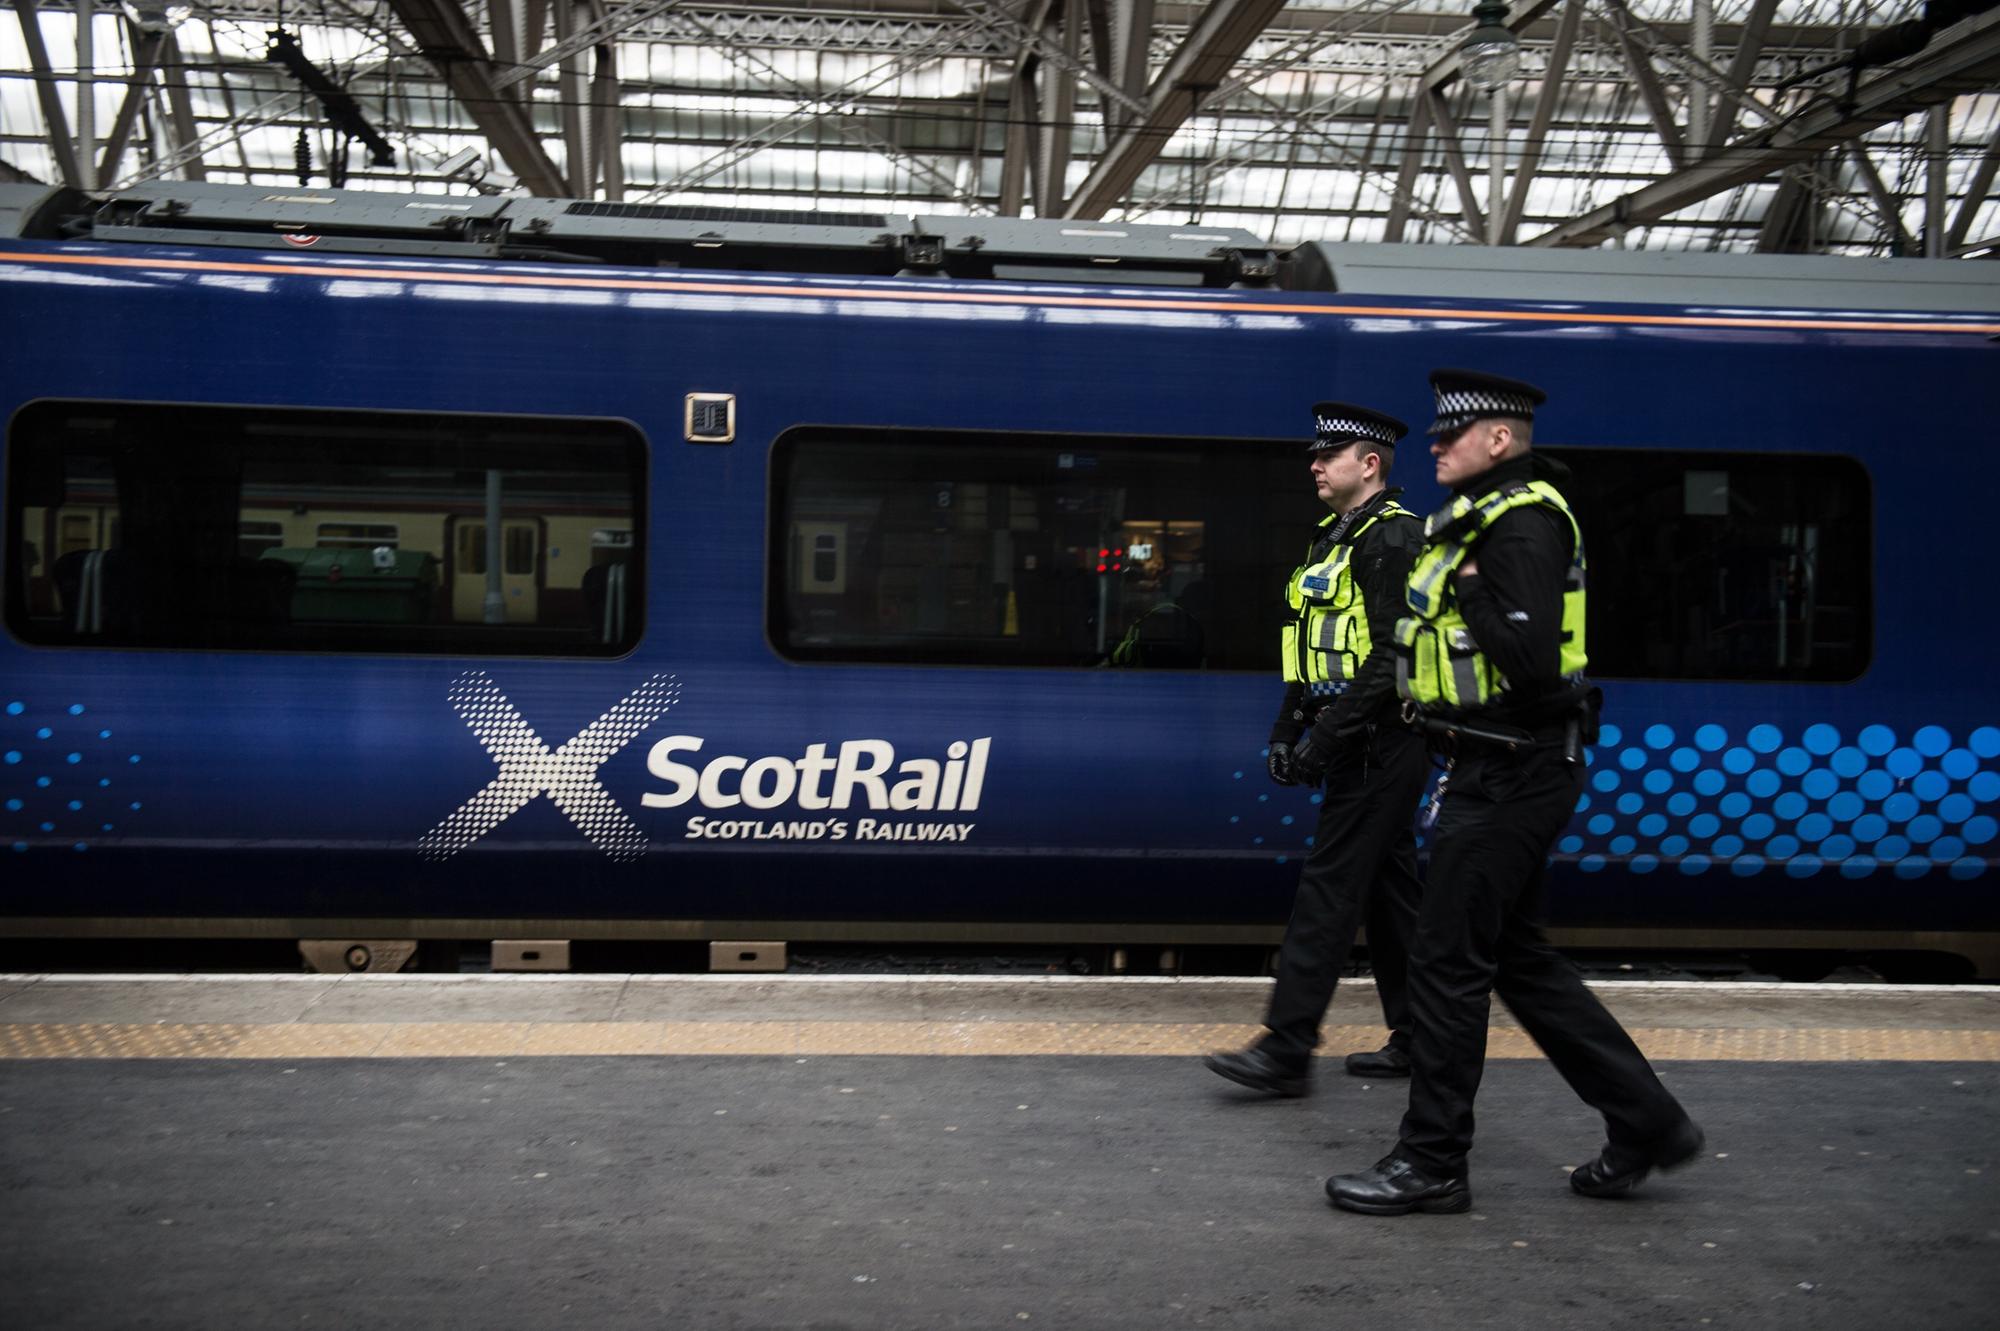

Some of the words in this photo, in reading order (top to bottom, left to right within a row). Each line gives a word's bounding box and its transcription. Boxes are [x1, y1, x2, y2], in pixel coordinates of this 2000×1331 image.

[641, 735, 991, 811] ScotRail
[685, 816, 848, 840] SCOTLAND'S
[856, 819, 975, 841] RAILWAY
